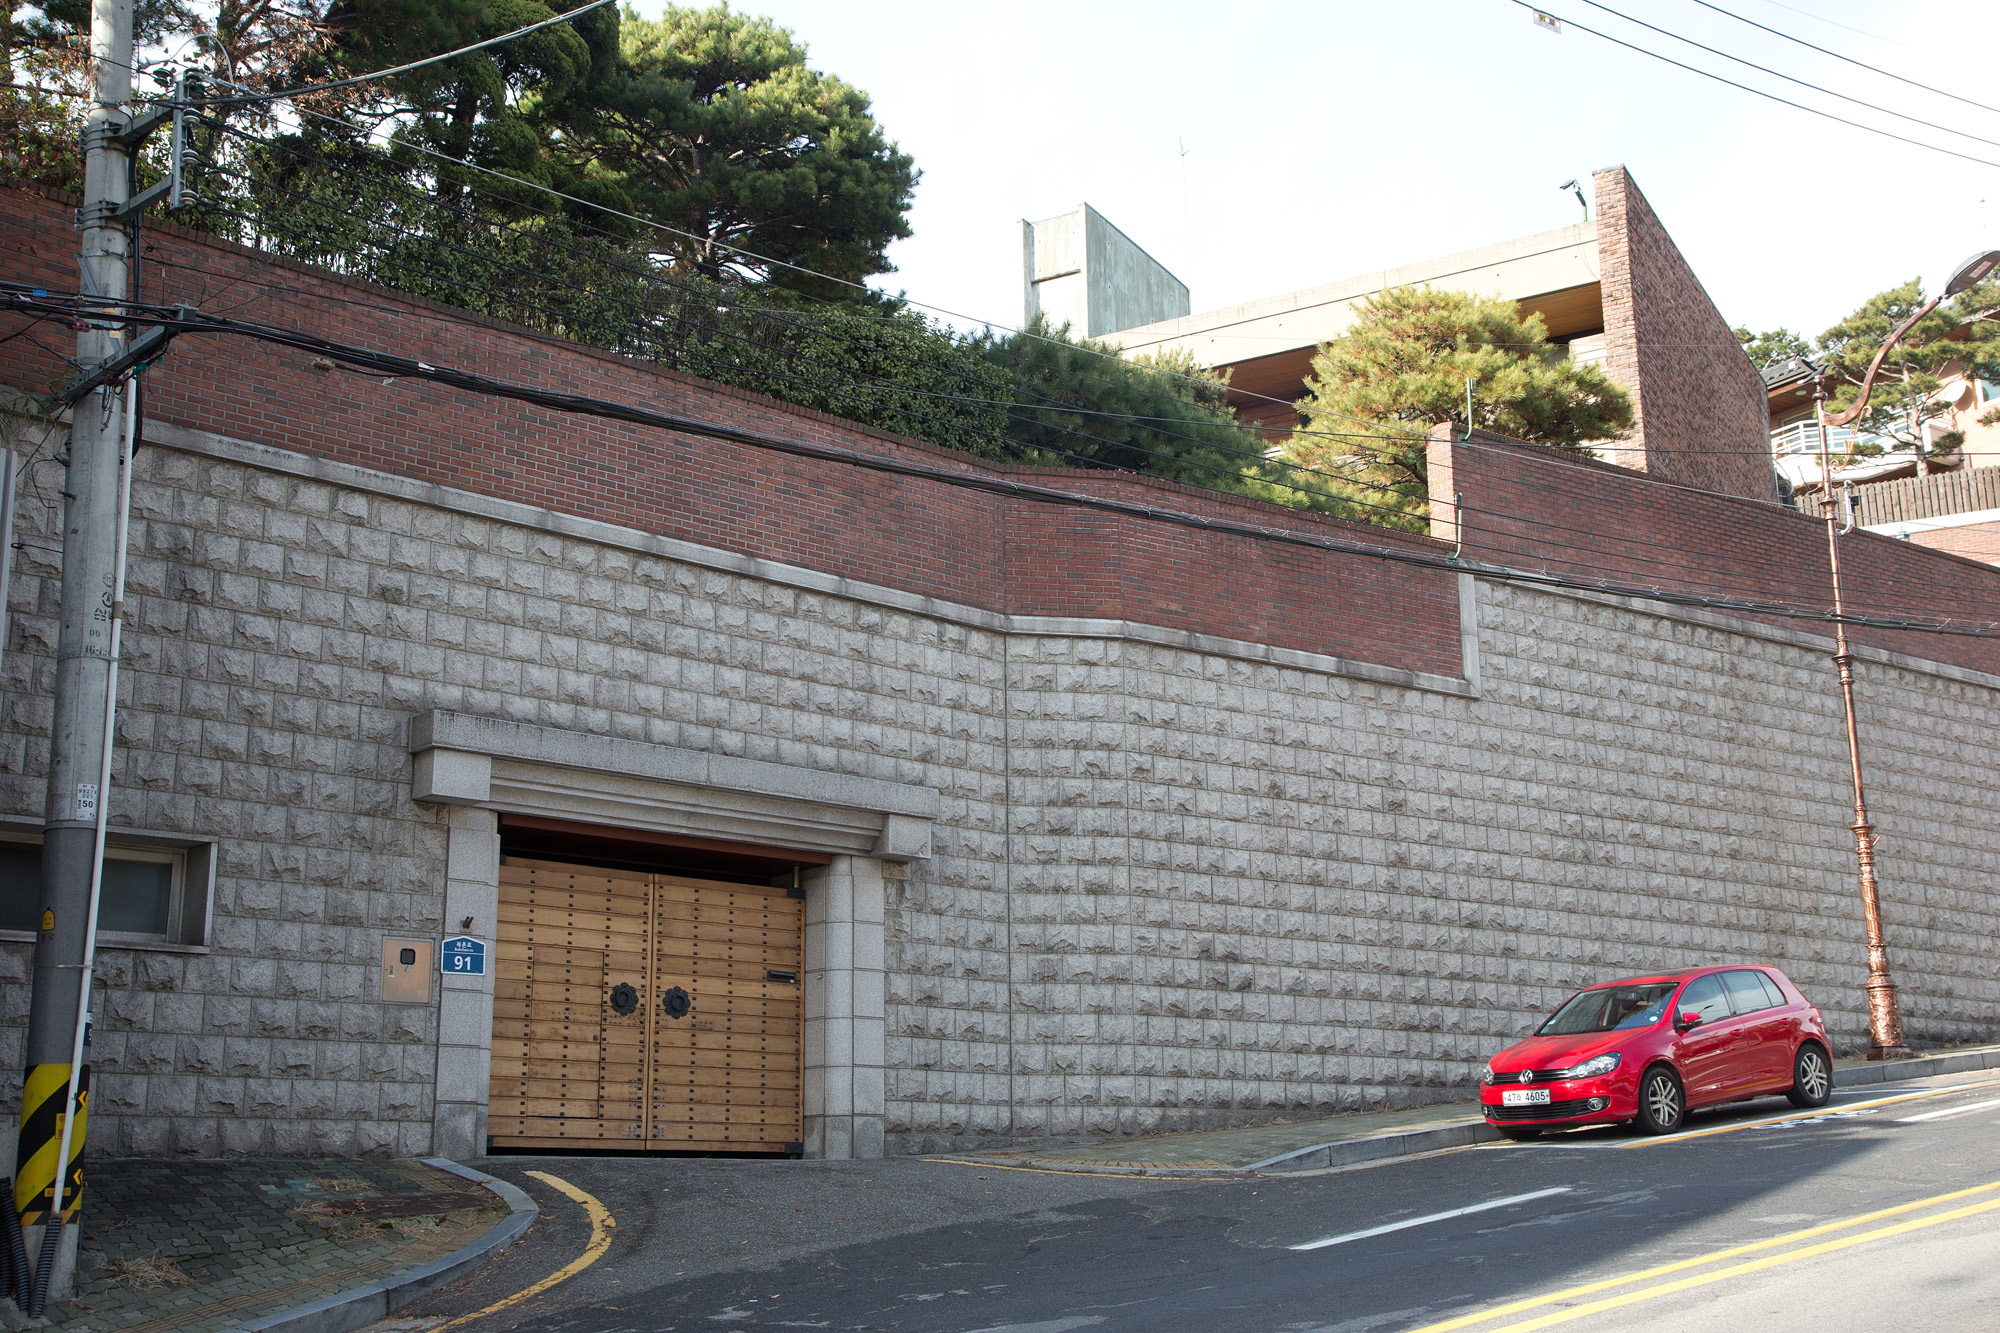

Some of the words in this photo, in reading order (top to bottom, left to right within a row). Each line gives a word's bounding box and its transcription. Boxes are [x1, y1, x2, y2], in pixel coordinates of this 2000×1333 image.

[82, 800, 94, 808] 50
[454, 955, 471, 971] 91
[1525, 1091, 1546, 1102] 4605
